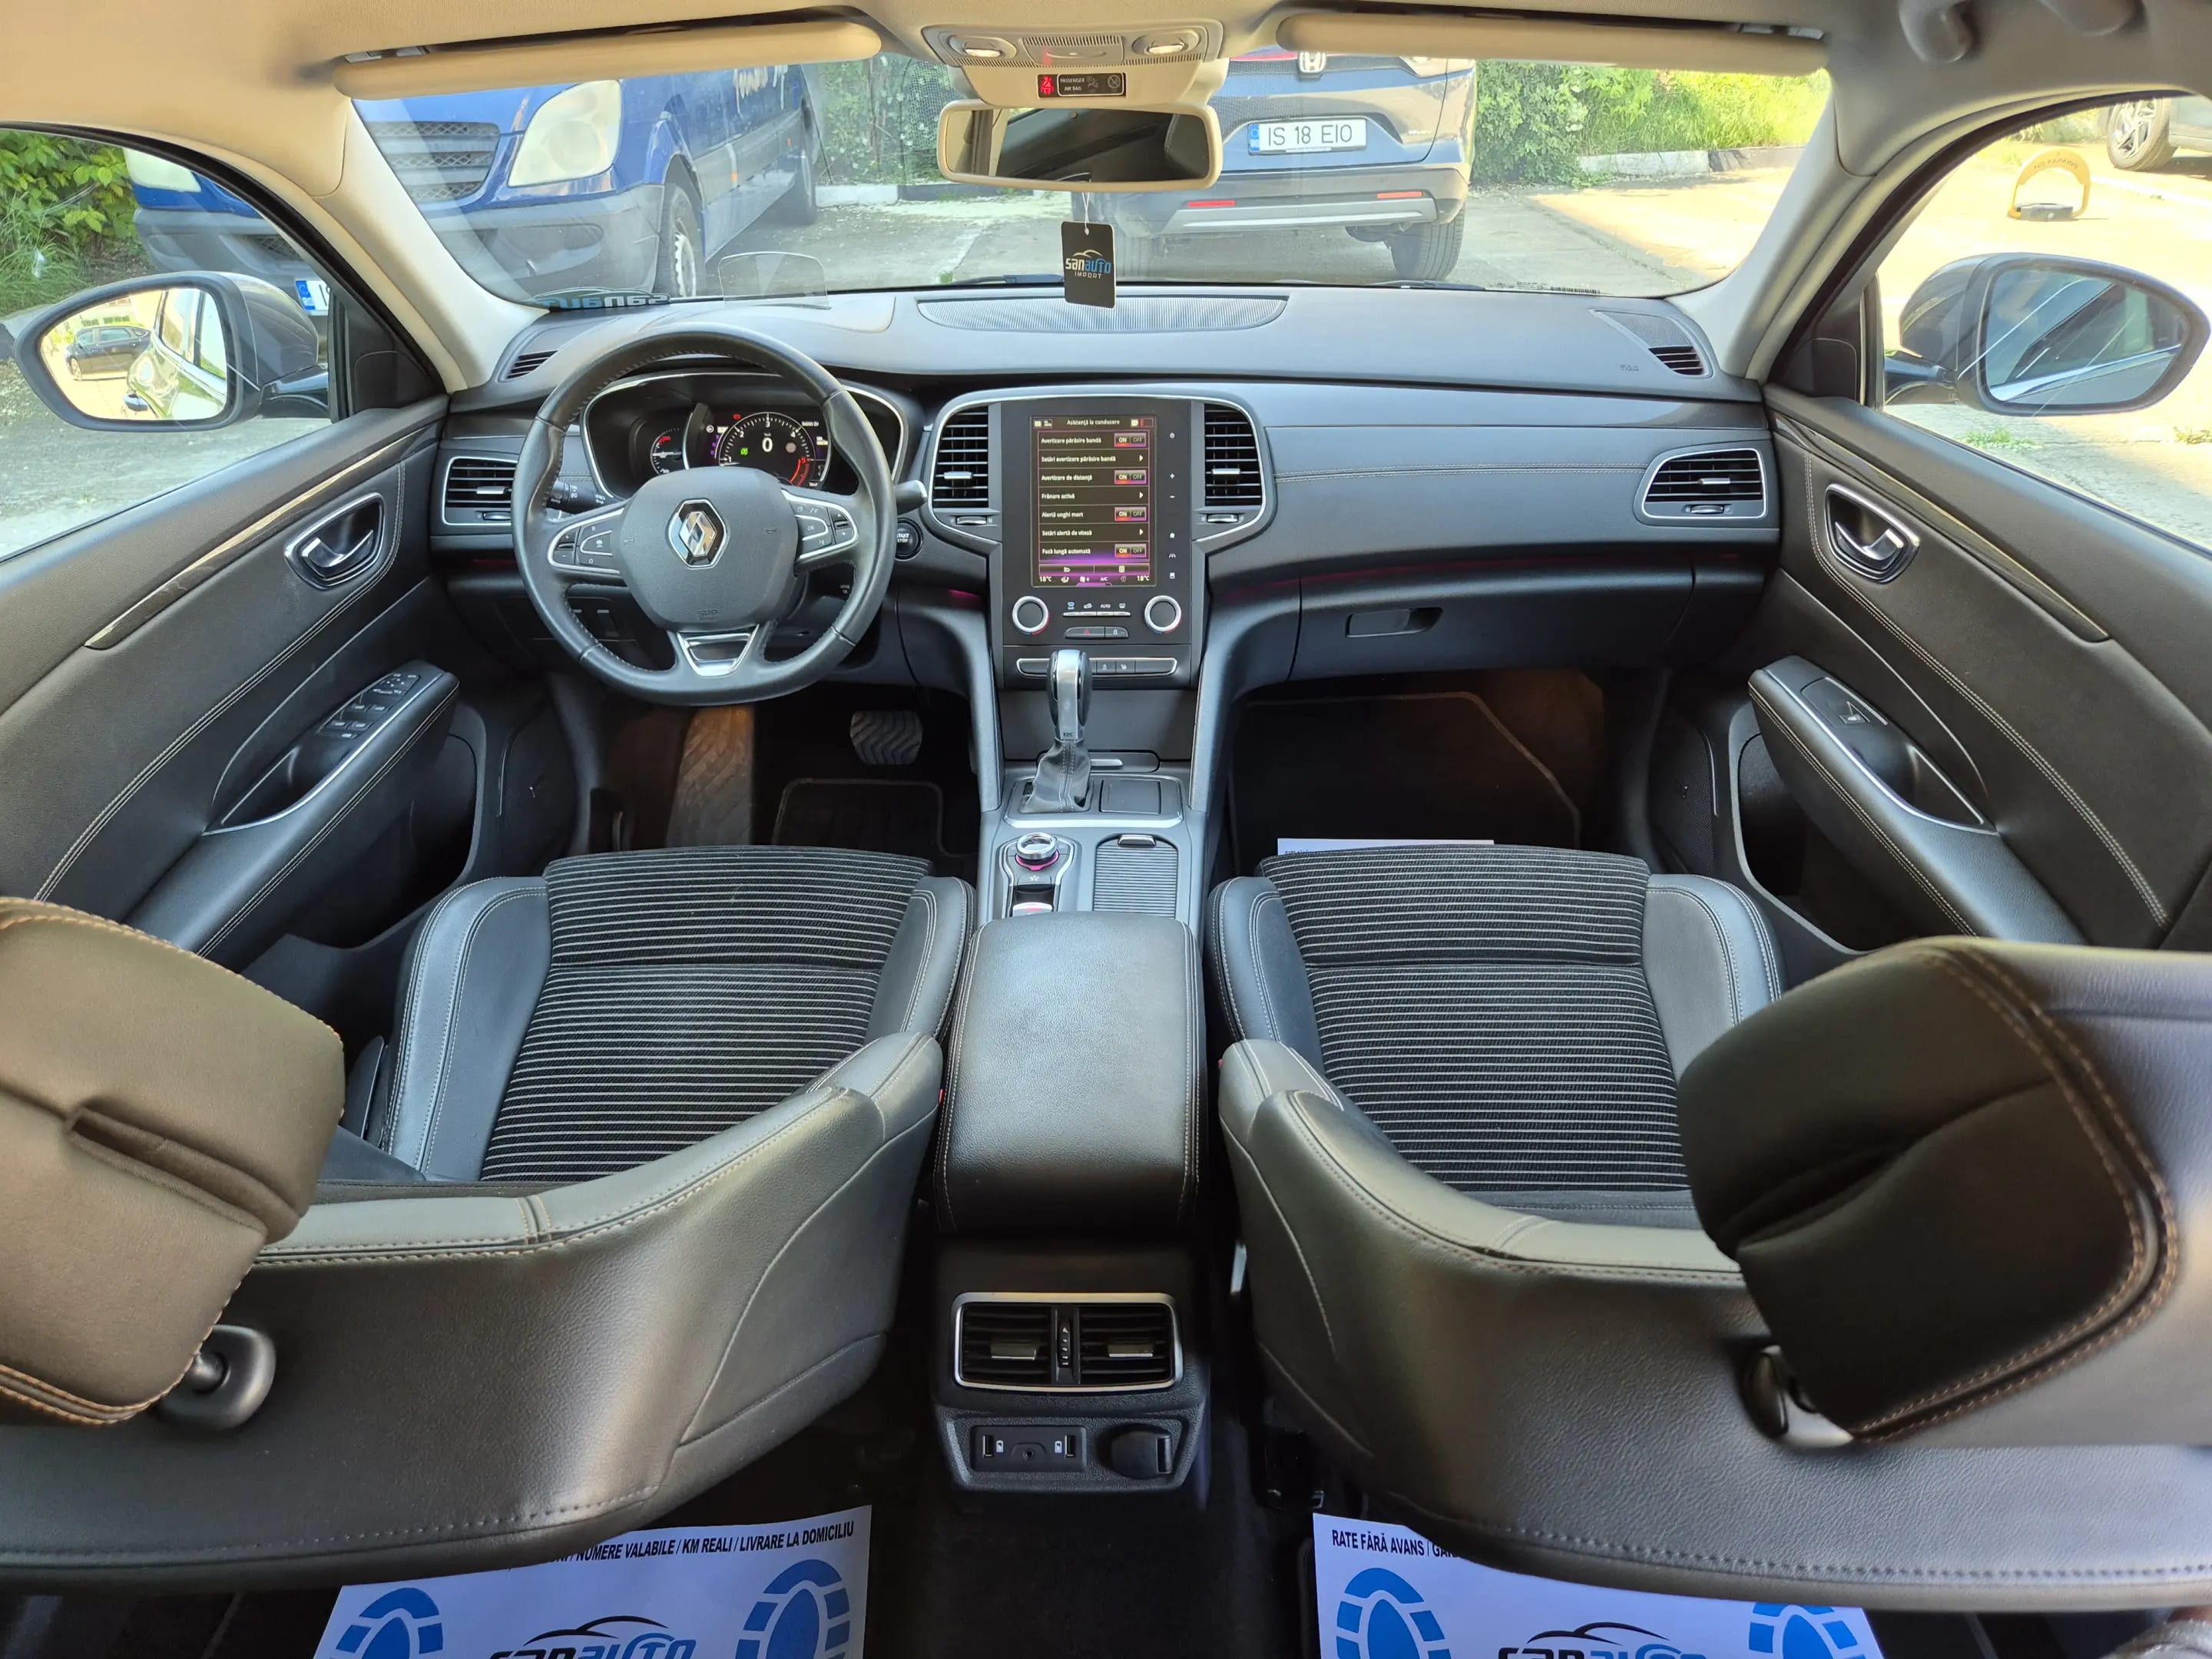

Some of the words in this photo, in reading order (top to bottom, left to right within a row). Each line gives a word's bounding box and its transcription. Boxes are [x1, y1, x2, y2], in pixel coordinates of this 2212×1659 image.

[1268, 127, 1286, 146] IS
[1295, 125, 1311, 144] 18
[1321, 124, 1353, 144] EIO
[762, 437, 773, 452] 0
[577, 1544, 624, 1561] NUMERE
[624, 1539, 676, 1558] VALABILE
[682, 1538, 700, 1554] KM
[701, 1536, 733, 1553] REALI
[740, 1533, 784, 1551] LIVRARE
[786, 1532, 800, 1548] LA
[802, 1521, 854, 1545] DOMICILIU
[1332, 1529, 1359, 1549] RATE
[1360, 1531, 1388, 1552] FĂRĂ
[1390, 1538, 1425, 1556] AVANS
